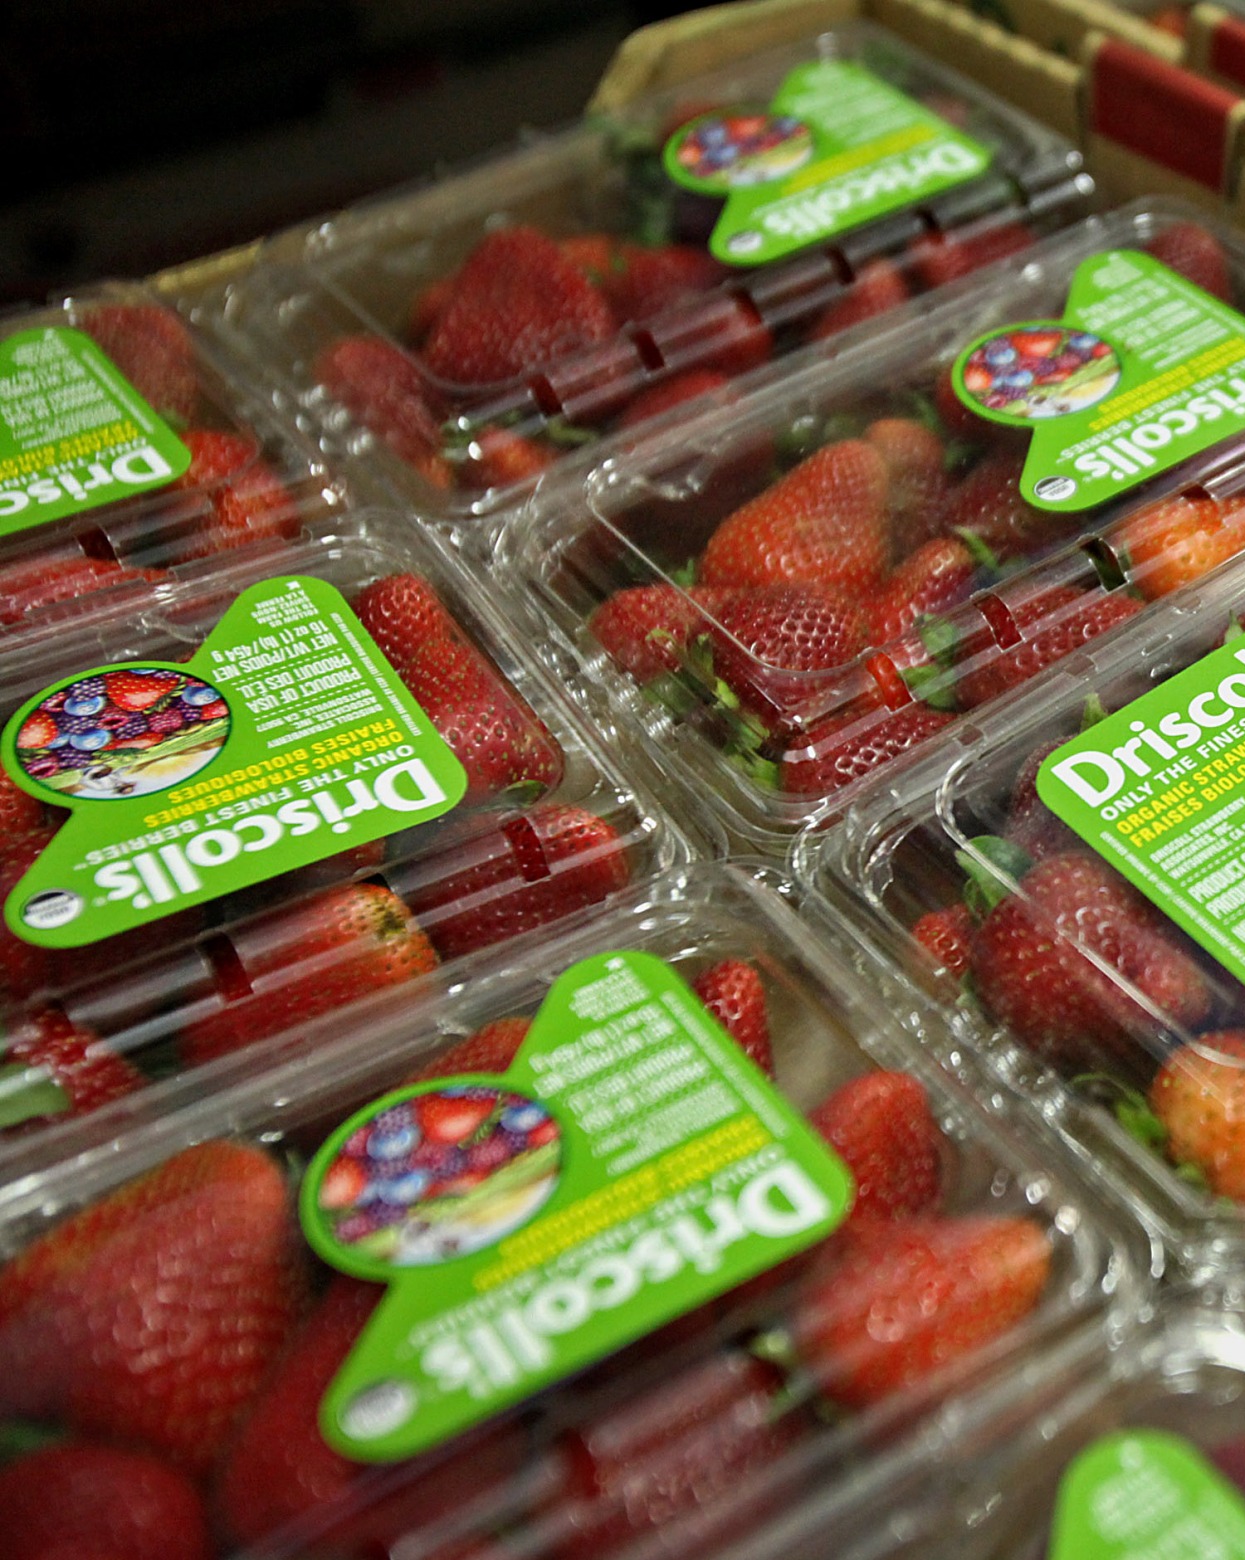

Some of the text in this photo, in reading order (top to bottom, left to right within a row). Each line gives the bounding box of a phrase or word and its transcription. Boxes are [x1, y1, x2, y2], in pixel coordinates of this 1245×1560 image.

[279, 629, 294, 644] (1
[294, 626, 309, 636] oz
[309, 620, 329, 634] 16
[211, 651, 224, 662] g
[212, 633, 338, 682] NET WT/POIDS NET
[225, 645, 252, 662] 454
[294, 653, 352, 681] PRODUIT
[246, 667, 362, 713] PRODUCT OF USA
[265, 672, 295, 690] DES
[144, 731, 404, 827] ORGANIC STRAWBERRIES
[168, 719, 396, 803] FRAISES BIOLOGIQUES
[86, 745, 414, 864] ONLY THE FINEST BERRIES
[1101, 781, 1153, 820] ONLY
[1154, 756, 1197, 784] THE
[1117, 781, 1194, 834] ORGANIC
[95, 758, 447, 908] Driscoll's
[1130, 798, 1203, 847] FRAISES
